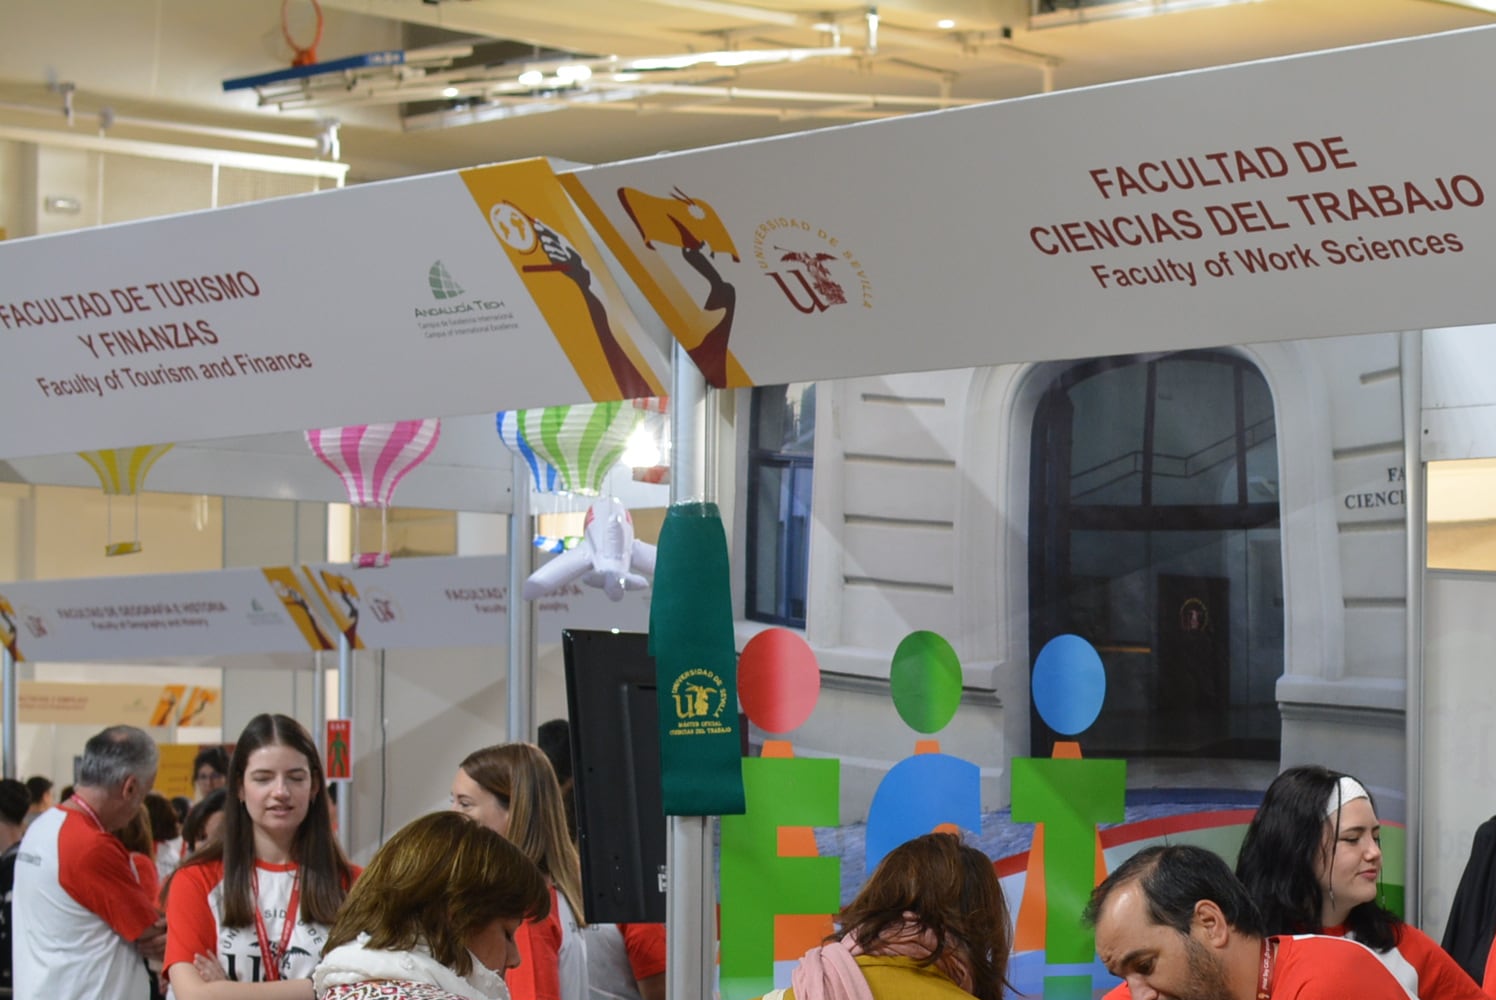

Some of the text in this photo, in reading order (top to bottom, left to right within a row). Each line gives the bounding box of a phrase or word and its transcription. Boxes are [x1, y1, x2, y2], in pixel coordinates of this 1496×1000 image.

[1089, 136, 1358, 199] FACULTAD DE
[1029, 174, 1485, 256] CIENCIAS DEL TRABAJO
[753, 216, 873, 309] UNIVERSIDAD DE SEVILLA
[1091, 232, 1464, 289] Faculty of Work Sciences
[0, 270, 261, 329] FACULTAD DE TURISMO
[78, 319, 219, 359] Y FINANZAS
[36, 352, 313, 397] Faculty of Tourism and Finance
[1344, 489, 1405, 510] CIENCI
